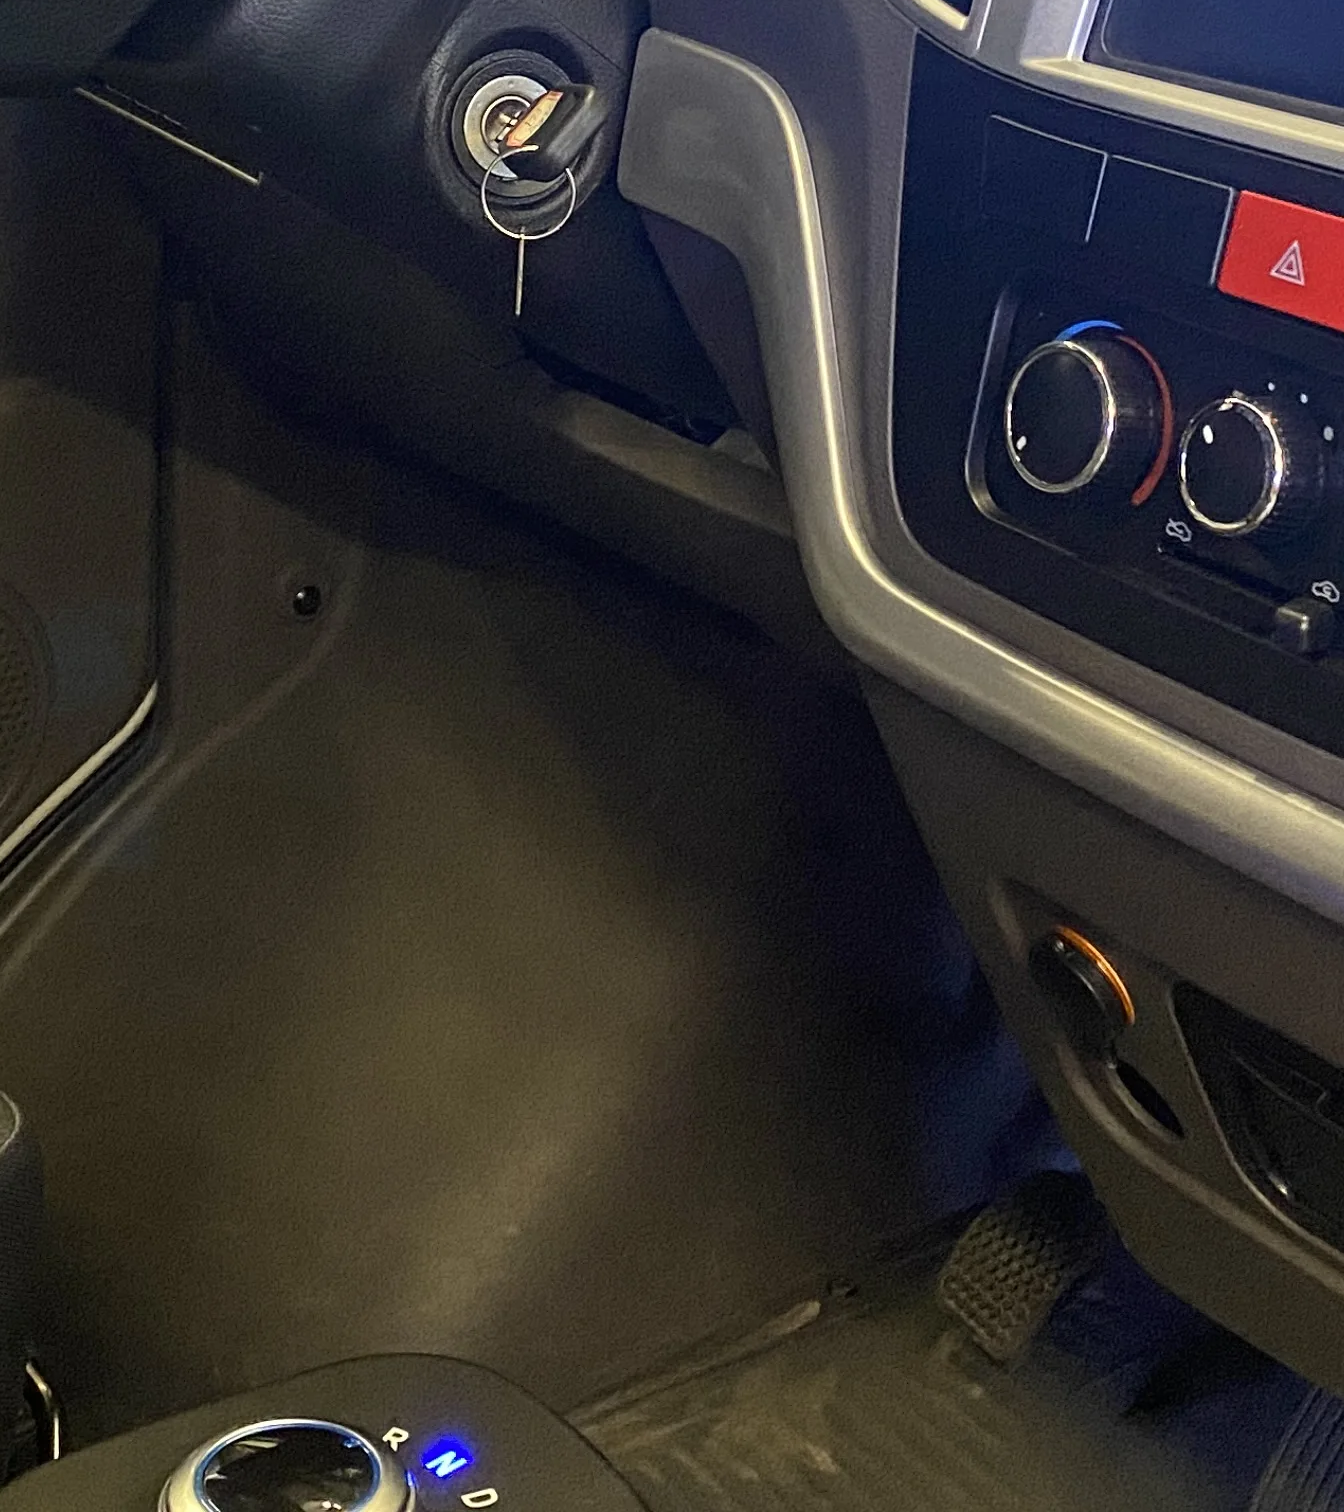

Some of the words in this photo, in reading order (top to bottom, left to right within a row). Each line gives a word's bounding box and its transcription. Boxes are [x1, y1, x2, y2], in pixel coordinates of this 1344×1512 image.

[382, 1426, 410, 1452] R
[424, 1450, 468, 1478] N
[460, 1487, 499, 1509] D
